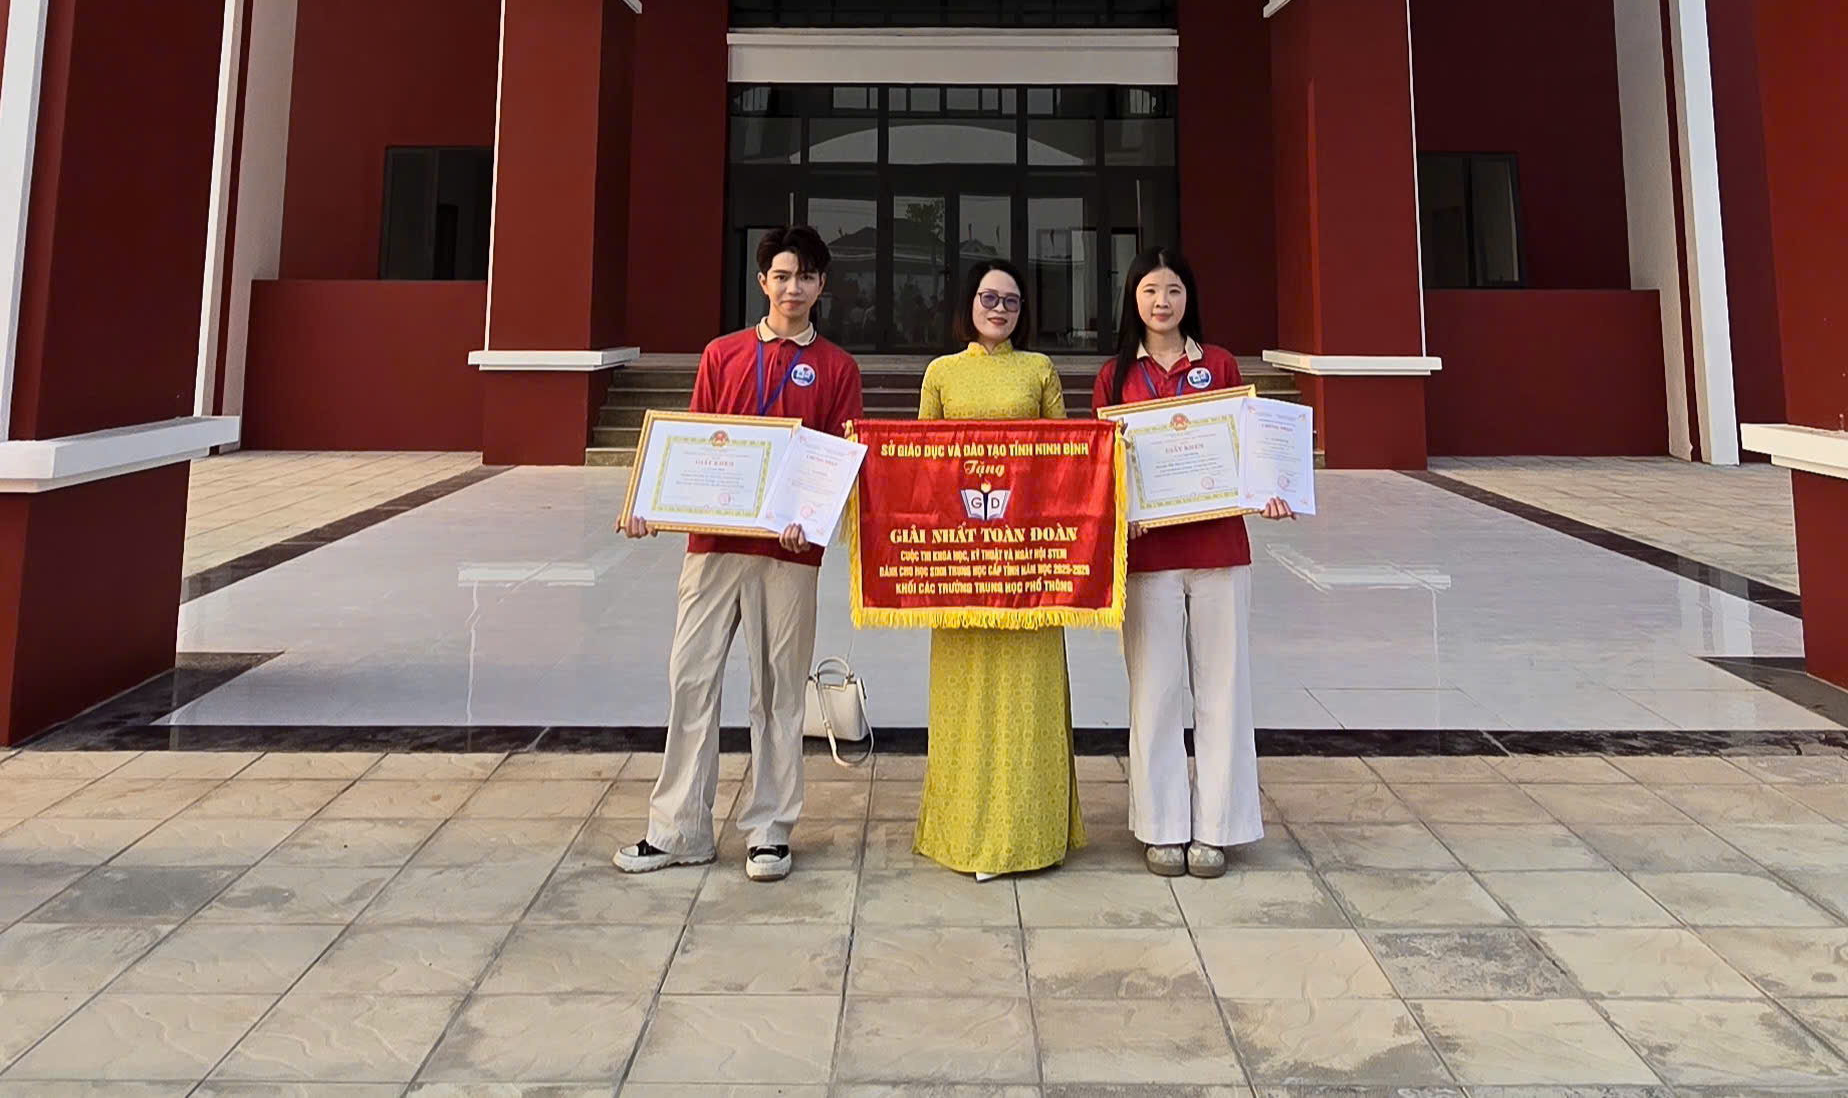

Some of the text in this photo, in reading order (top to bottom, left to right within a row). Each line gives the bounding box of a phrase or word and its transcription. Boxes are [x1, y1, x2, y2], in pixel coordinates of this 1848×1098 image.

[897, 441, 922, 457] GIÁO
[924, 444, 945, 460] DỤC
[947, 442, 962, 457] VÀ
[987, 444, 1007, 459] TẠO
[1035, 443, 1062, 456] NINH
[963, 459, 1005, 478] Tặng
[971, 497, 1000, 509] G D
[890, 521, 1078, 544] GIẢI NHẤT TOÀN ĐOÀN
